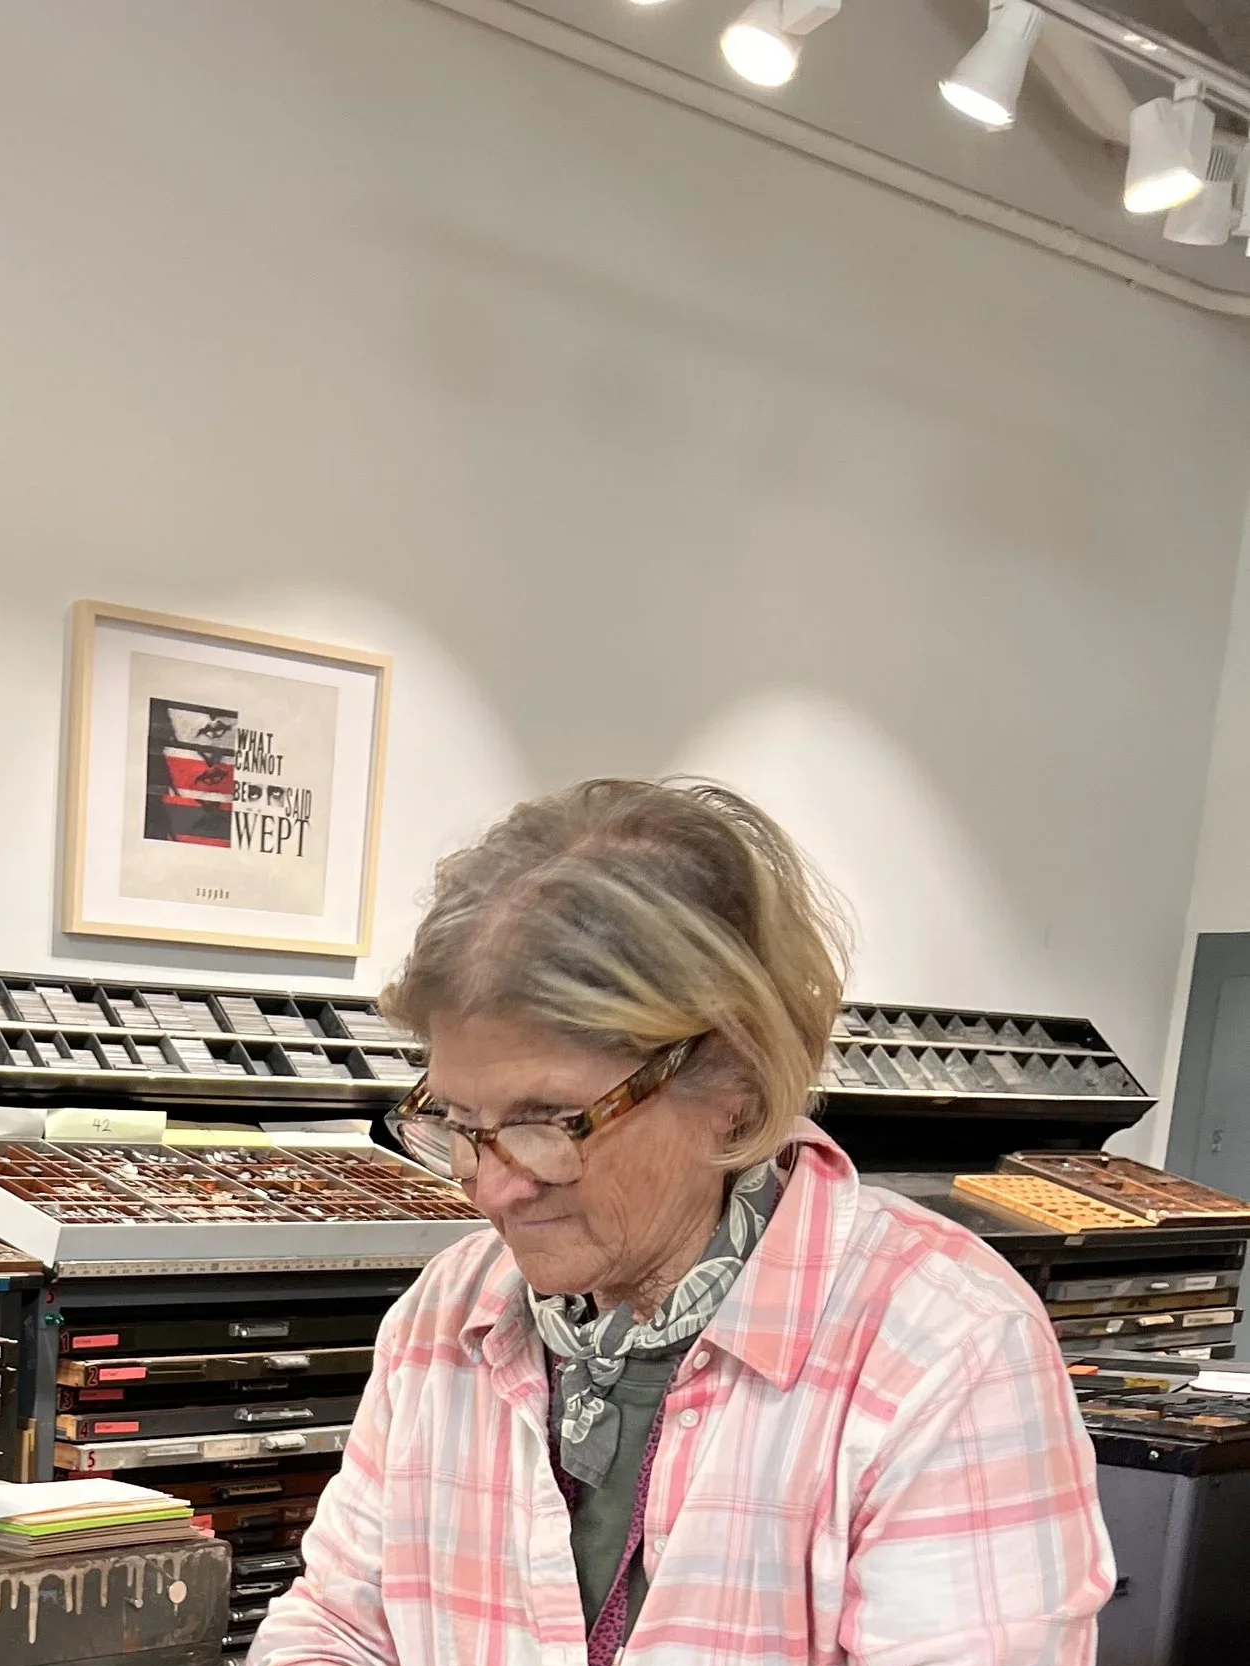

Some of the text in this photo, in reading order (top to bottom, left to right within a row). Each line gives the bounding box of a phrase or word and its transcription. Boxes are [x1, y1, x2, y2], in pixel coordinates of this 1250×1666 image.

[237, 728, 274, 754] WHAT
[235, 750, 283, 776] CANNOT
[233, 780, 312, 819] BE SAID
[234, 811, 311, 857] WEPT
[92, 1118, 112, 1133] 42
[61, 1331, 70, 1352] 1
[88, 1366, 99, 1386] 2
[80, 1422, 89, 1440] 4
[87, 1450, 95, 1469] 5
